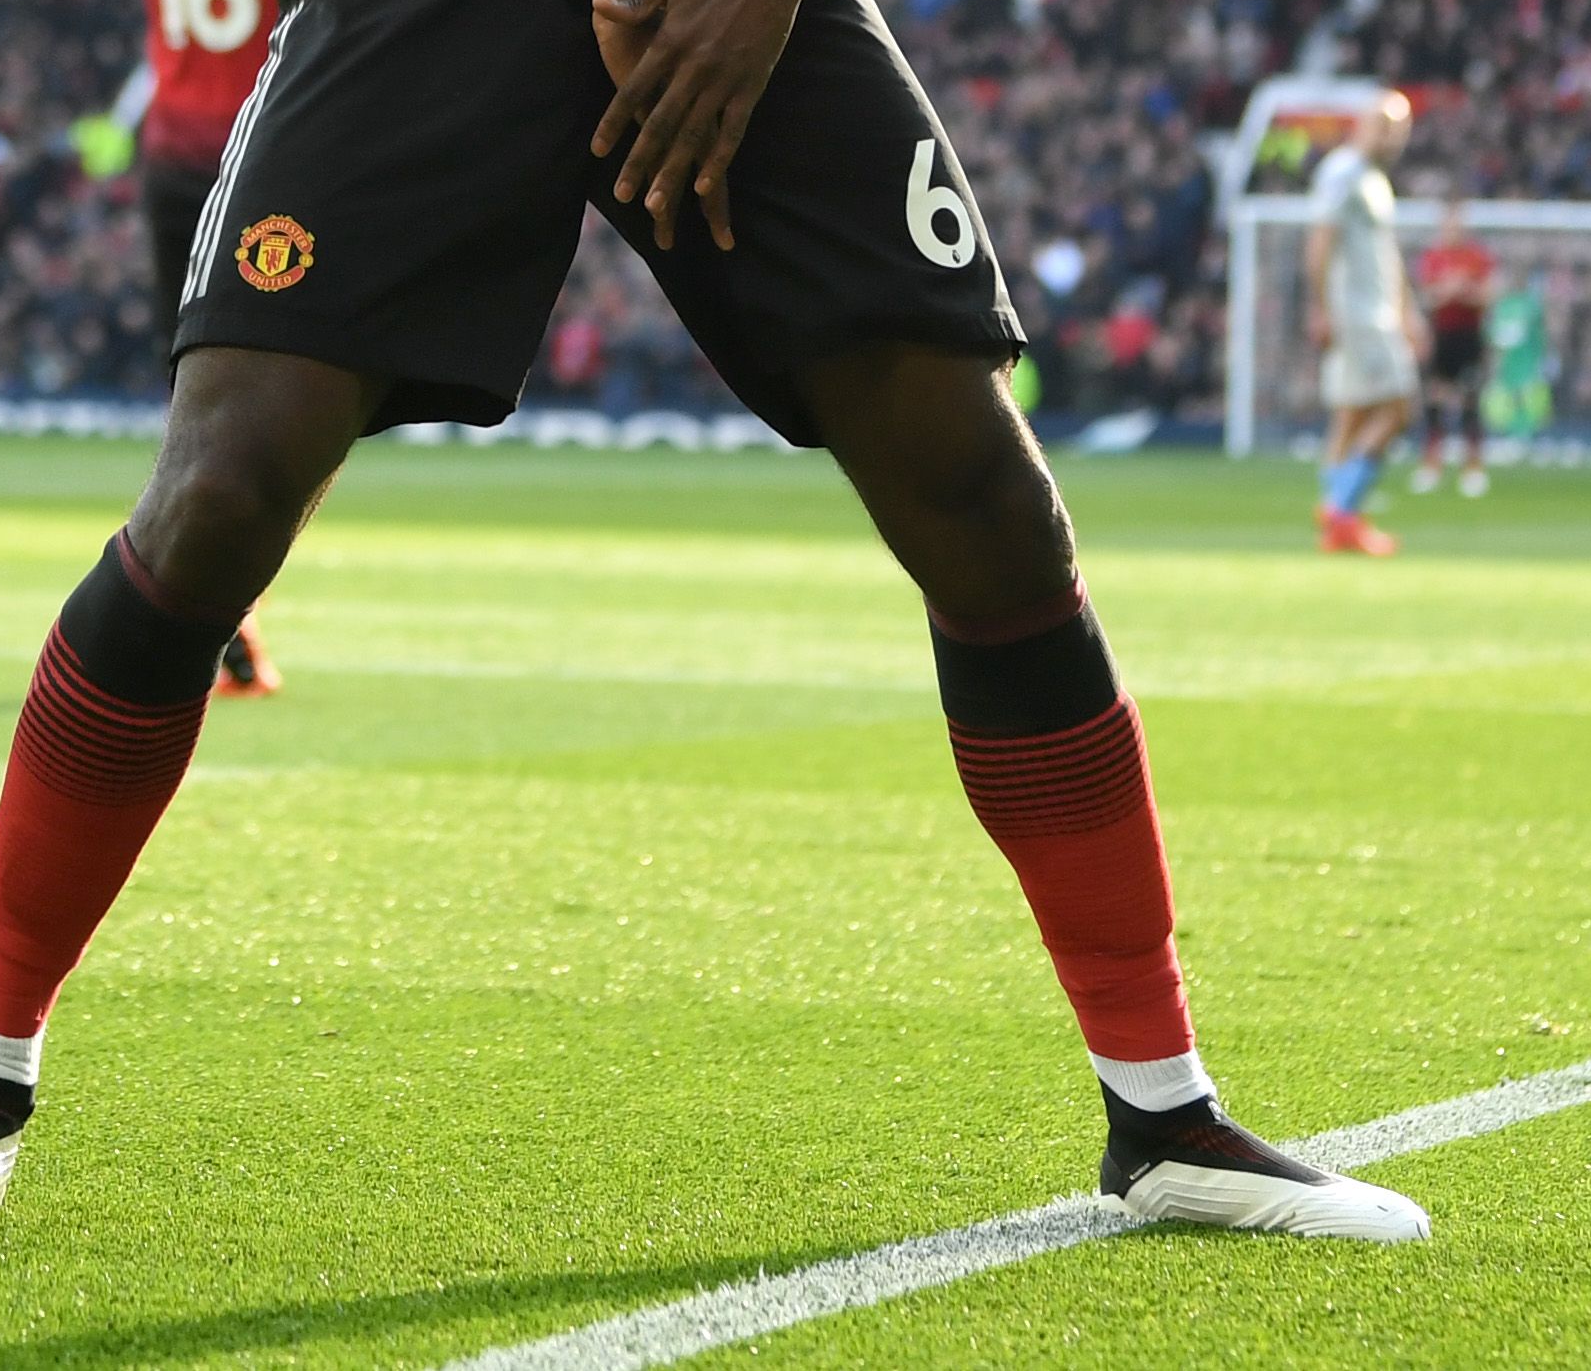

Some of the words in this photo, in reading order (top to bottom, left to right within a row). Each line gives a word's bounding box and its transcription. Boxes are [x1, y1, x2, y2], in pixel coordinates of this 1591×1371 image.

[905, 138, 976, 269] 6
[246, 221, 308, 248] MANCHESTER
[248, 272, 292, 287] UNITED
